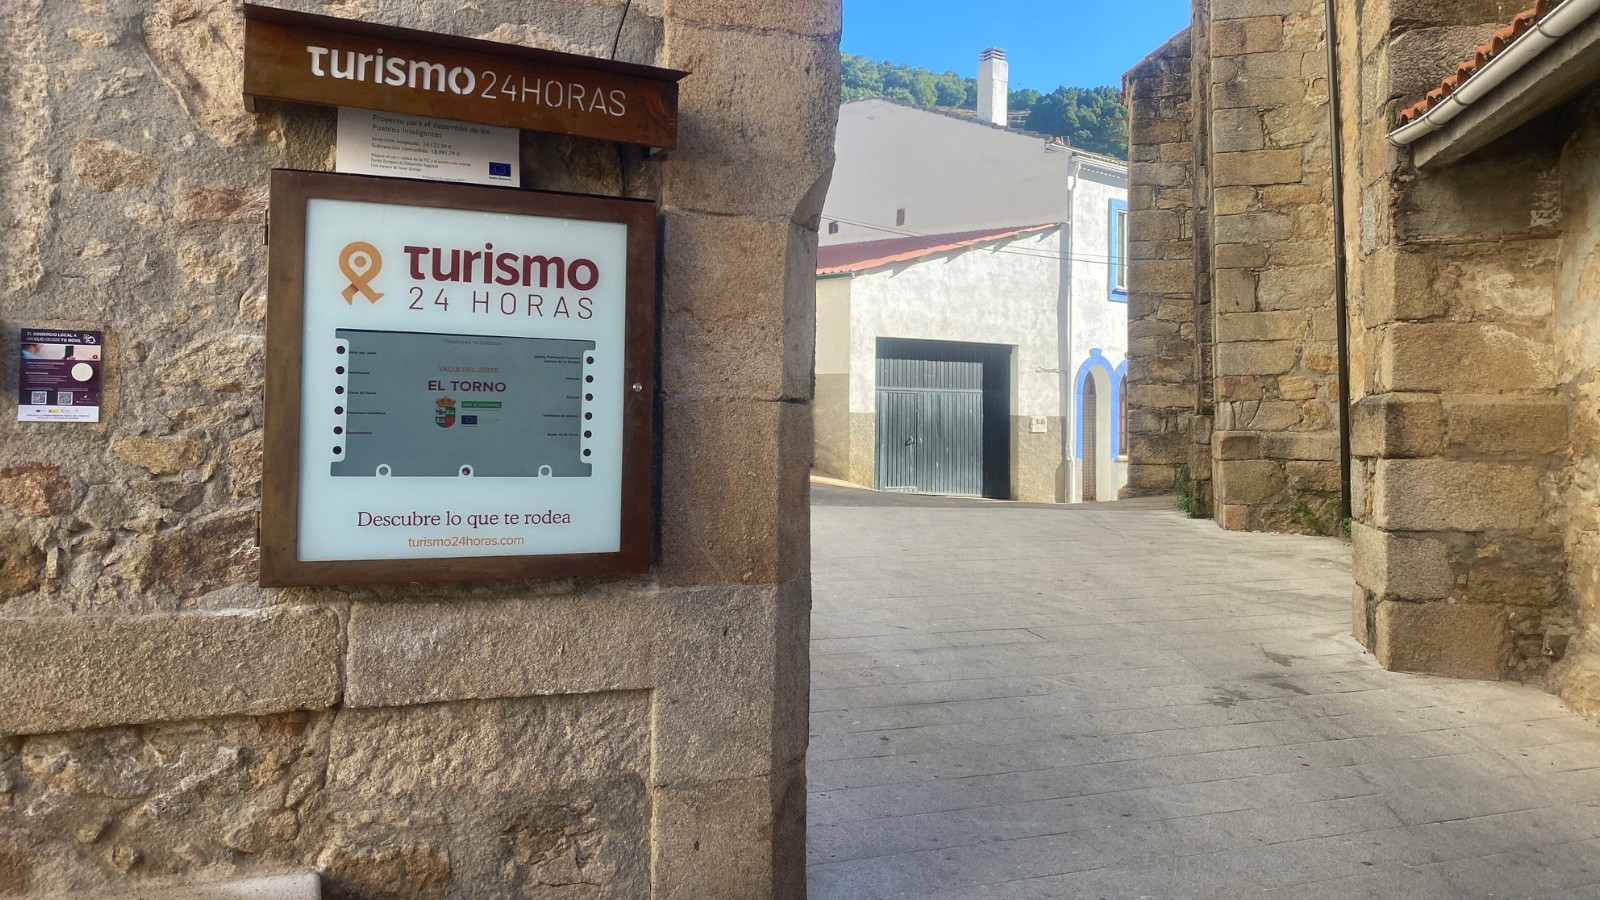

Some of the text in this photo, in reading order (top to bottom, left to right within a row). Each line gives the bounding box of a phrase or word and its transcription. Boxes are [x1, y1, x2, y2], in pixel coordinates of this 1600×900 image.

[306, 45, 627, 118] turismo 24HORAS
[372, 114, 405, 125] Proyecto
[432, 122, 468, 132] desarrollo
[480, 127, 490, 135] los
[372, 123, 442, 138] Pueblos Inteligentes
[403, 242, 600, 291] turismo
[408, 286, 595, 320] 24 HORAS
[428, 380, 507, 392] EL TORNO
[357, 510, 571, 531] Descubre lo que te rodea
[407, 535, 525, 547] turismo24horas.com
